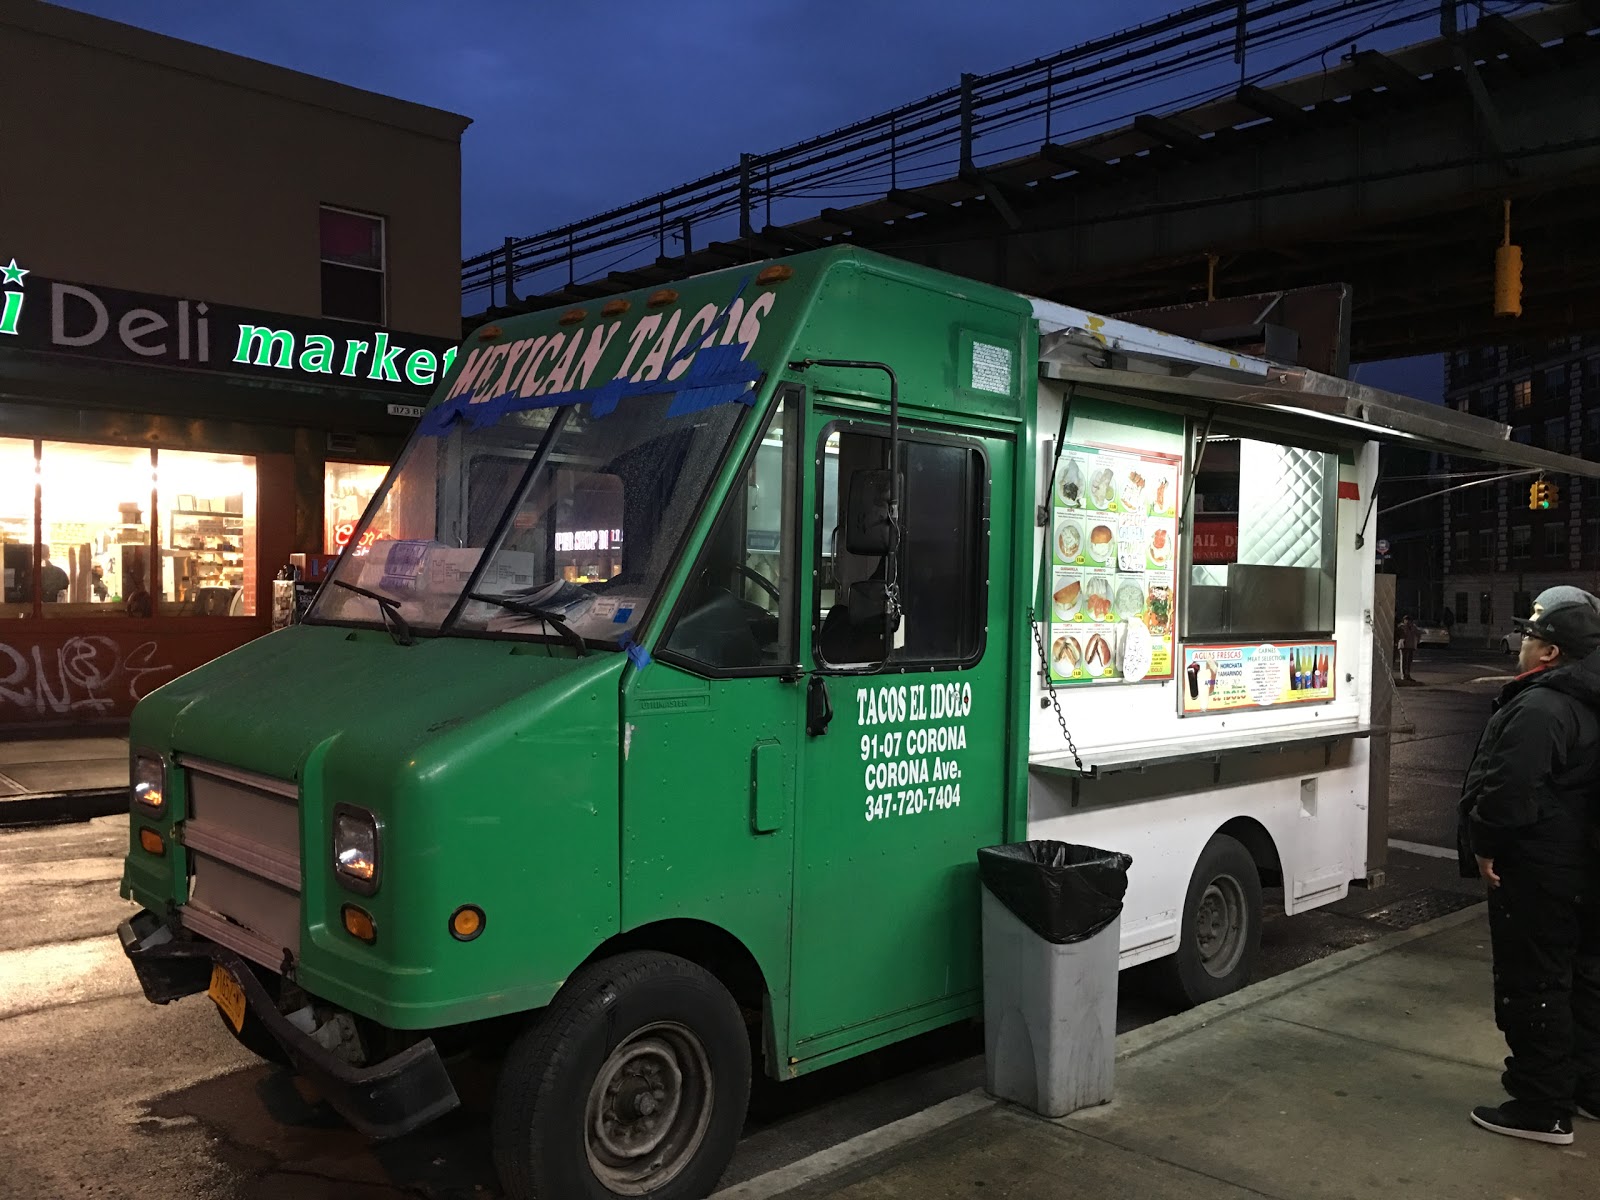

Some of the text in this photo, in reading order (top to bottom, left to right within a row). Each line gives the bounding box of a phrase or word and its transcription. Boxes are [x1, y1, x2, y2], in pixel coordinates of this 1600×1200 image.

[51, 282, 209, 362] Deli
[445, 292, 776, 404] MEXICAN TACOS
[1194, 650, 1241, 660] AGUAS FRESCAS
[857, 682, 971, 725] TACOS EL IDOLO
[860, 725, 966, 760] 91-07 CORONA
[865, 757, 961, 790] CORONA Ave.
[865, 783, 960, 821] 347-720-7404
